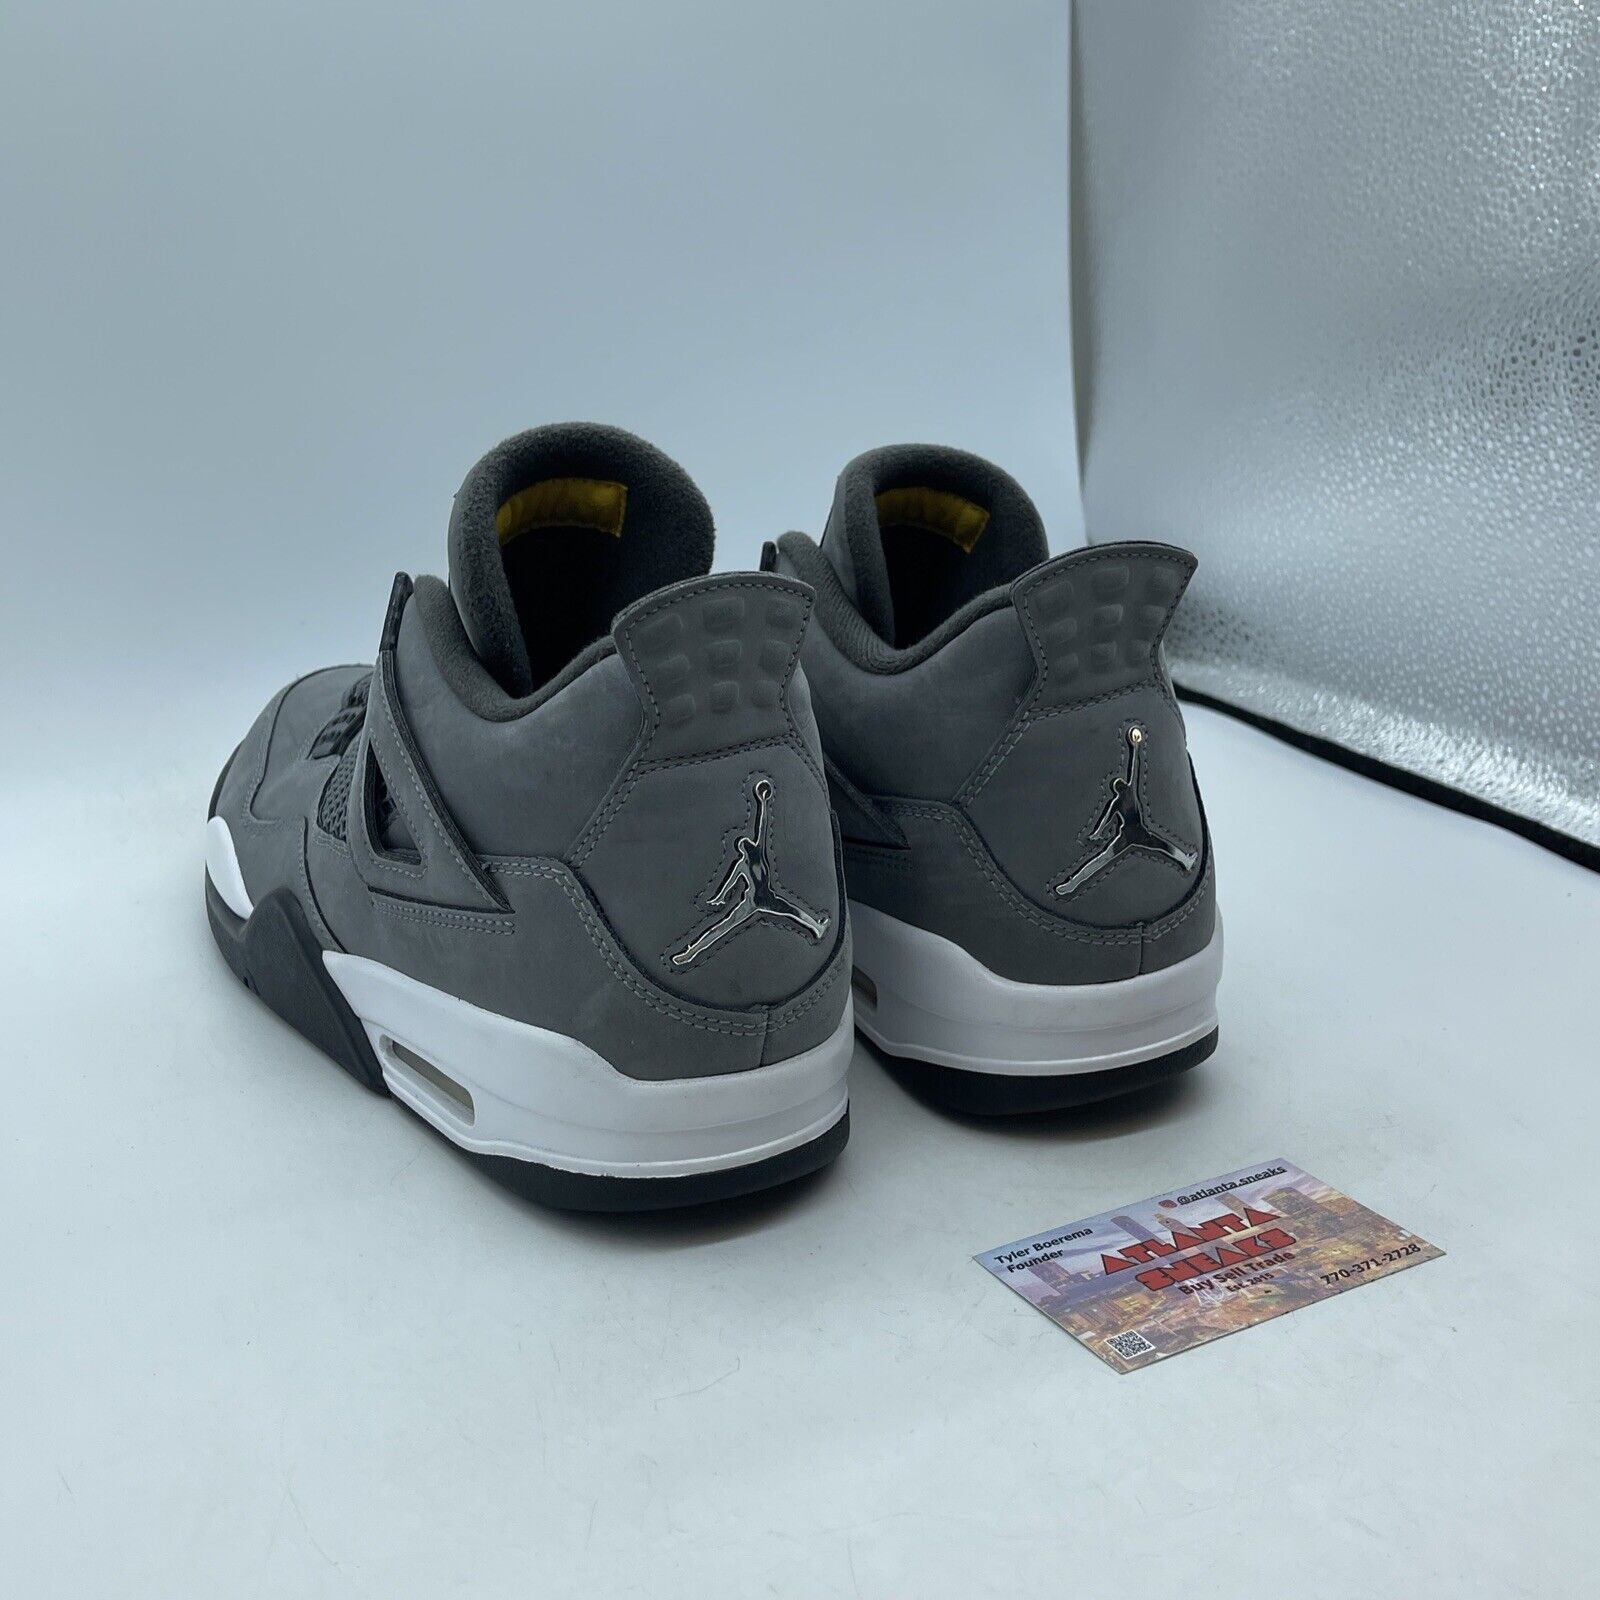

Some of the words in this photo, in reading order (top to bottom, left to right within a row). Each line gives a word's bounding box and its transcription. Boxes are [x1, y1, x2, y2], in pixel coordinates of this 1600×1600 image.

[1177, 1166, 1287, 1205] @atlanta.sneaks
[994, 1247, 1029, 1264] Tyler
[1032, 1227, 1093, 1252] Boerema
[1007, 1248, 1064, 1273] Founder
[1101, 1207, 1282, 1275] ATLANTA
[1135, 1228, 1297, 1291] SNEAKS
[1178, 1280, 1214, 1296] Buy
[1212, 1267, 1247, 1283] Sell
[1244, 1252, 1296, 1272] Trade
[1249, 1272, 1275, 1286] 2015
[1320, 1243, 1421, 1285] 770-371-2728
